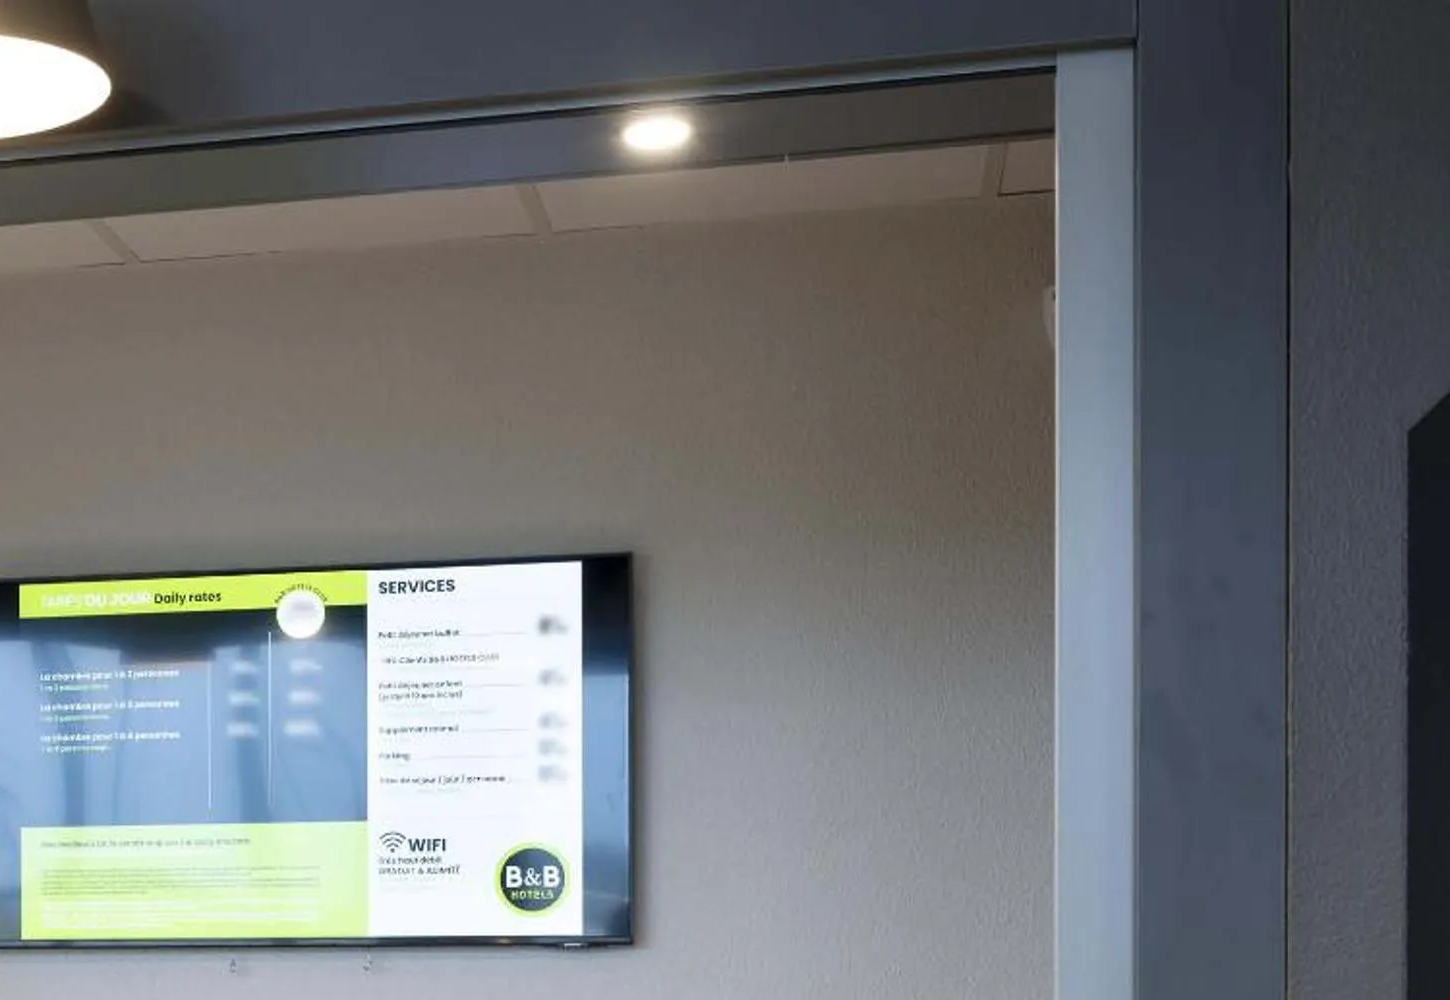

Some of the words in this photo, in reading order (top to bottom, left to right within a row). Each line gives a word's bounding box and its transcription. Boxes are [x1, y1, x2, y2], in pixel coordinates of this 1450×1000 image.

[378, 579, 455, 594] SERVICES
[154, 592, 186, 605] Daily
[189, 591, 221, 603] rates
[408, 838, 446, 851] WIFI
[506, 865, 560, 888] B&B
[511, 890, 554, 901] HOTELS
